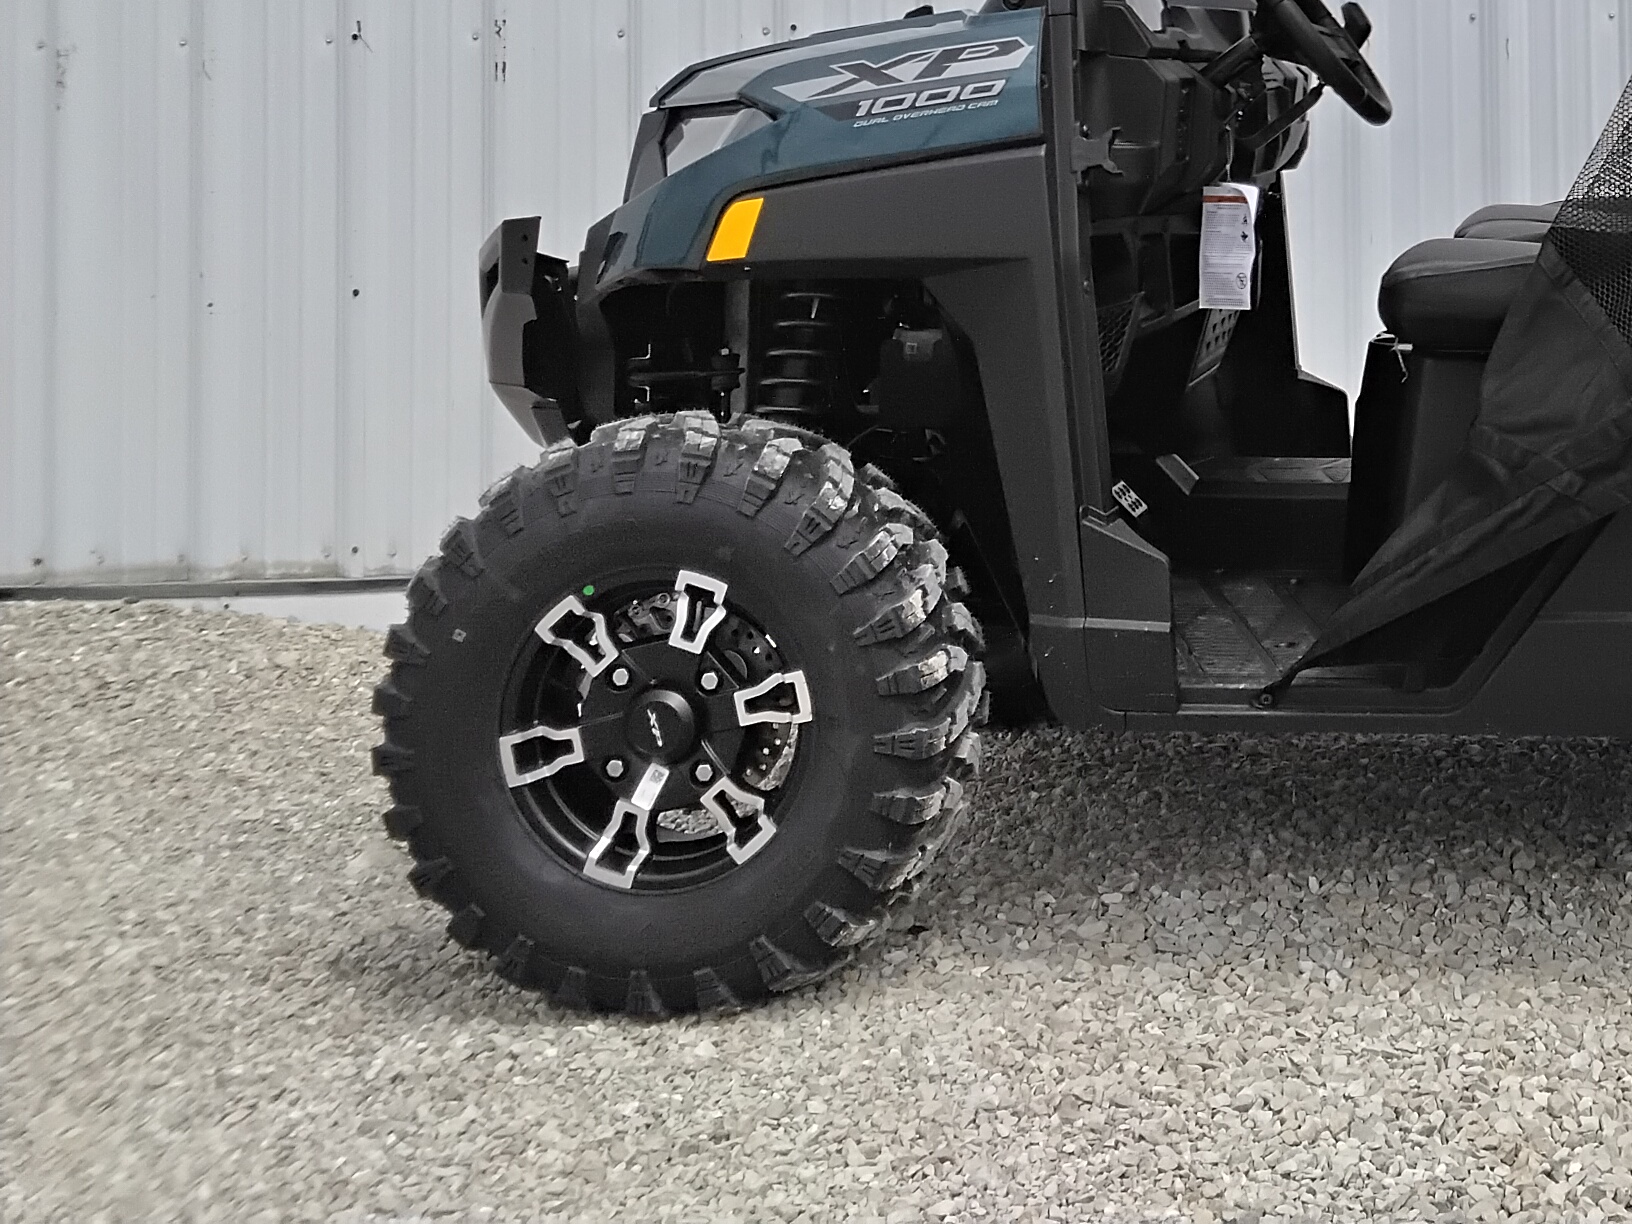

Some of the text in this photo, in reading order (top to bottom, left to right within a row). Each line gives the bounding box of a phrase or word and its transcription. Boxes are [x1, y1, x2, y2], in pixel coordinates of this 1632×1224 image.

[808, 36, 1028, 101] XP
[852, 98, 999, 128] DUAL OVERHEAD CAM
[855, 78, 1008, 118] 1000
[646, 708, 664, 748] XP
